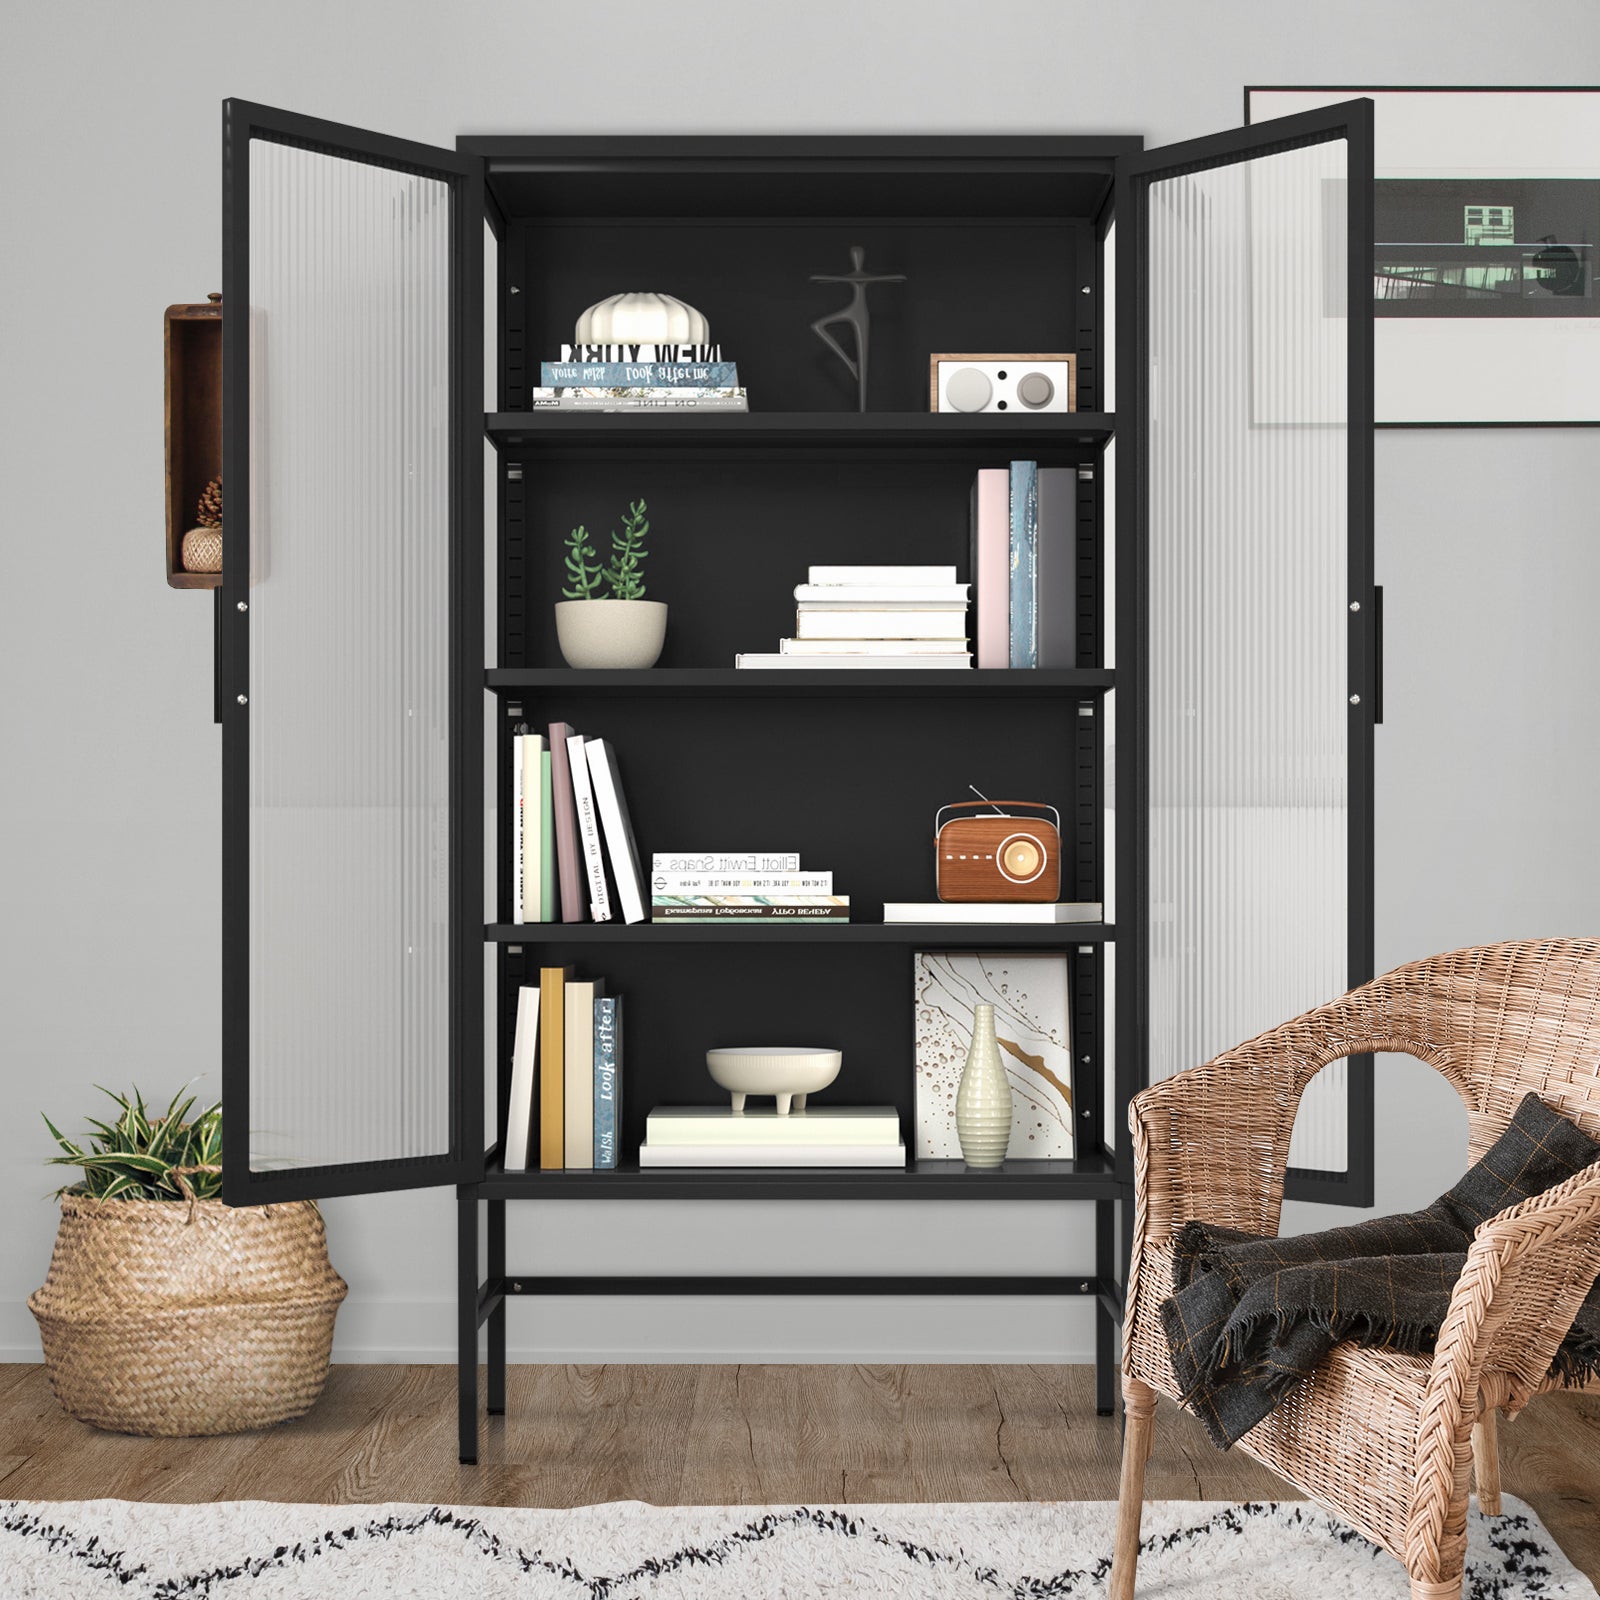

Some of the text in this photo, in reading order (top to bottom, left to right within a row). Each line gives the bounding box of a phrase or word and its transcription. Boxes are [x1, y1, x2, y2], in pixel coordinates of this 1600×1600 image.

[582, 797, 594, 836] DESIGN
[593, 864, 605, 904] DIGITAL
[598, 1007, 613, 1053] after
[598, 1062, 615, 1101] Look
